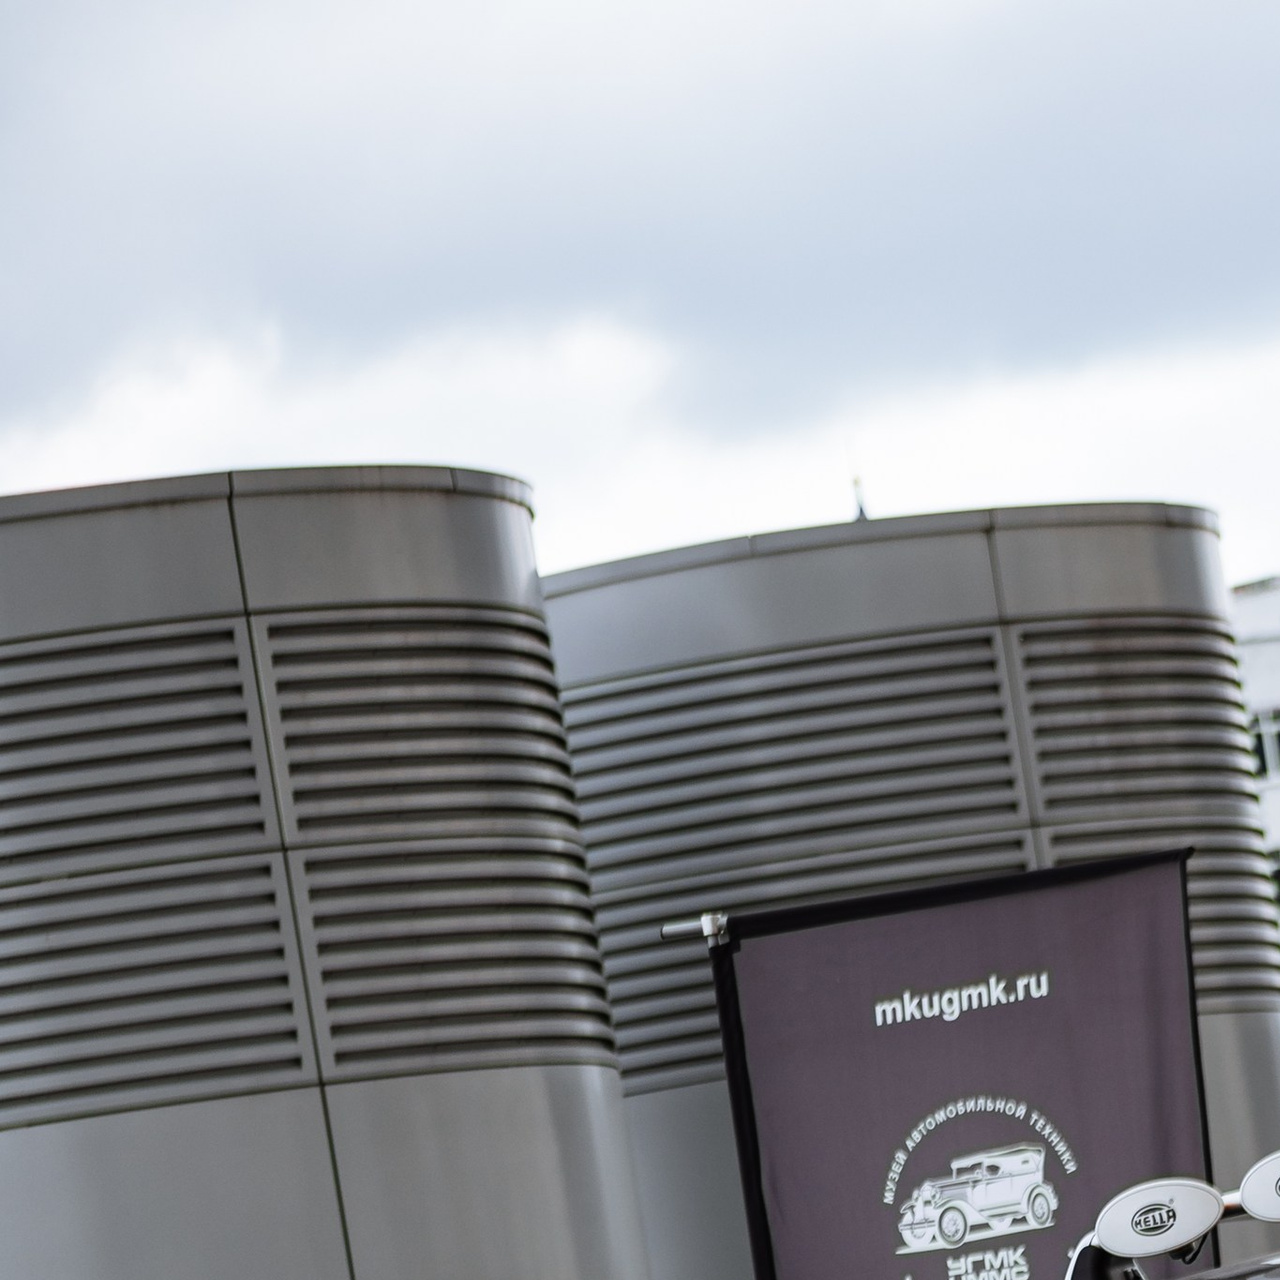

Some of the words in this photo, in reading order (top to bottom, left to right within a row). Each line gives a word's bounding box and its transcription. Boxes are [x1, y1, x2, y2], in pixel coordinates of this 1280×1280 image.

[875, 971, 1049, 1026] mkugmk.ru
[884, 1150, 908, 1205] МУЗЕЙ
[905, 1095, 1027, 1152] АВТОМОБИЛЬНОЙ
[1029, 1113, 1077, 1175] ТЕХНИКИ
[1134, 1209, 1176, 1232] HELLA
[947, 1244, 1029, 1273] УГМК
